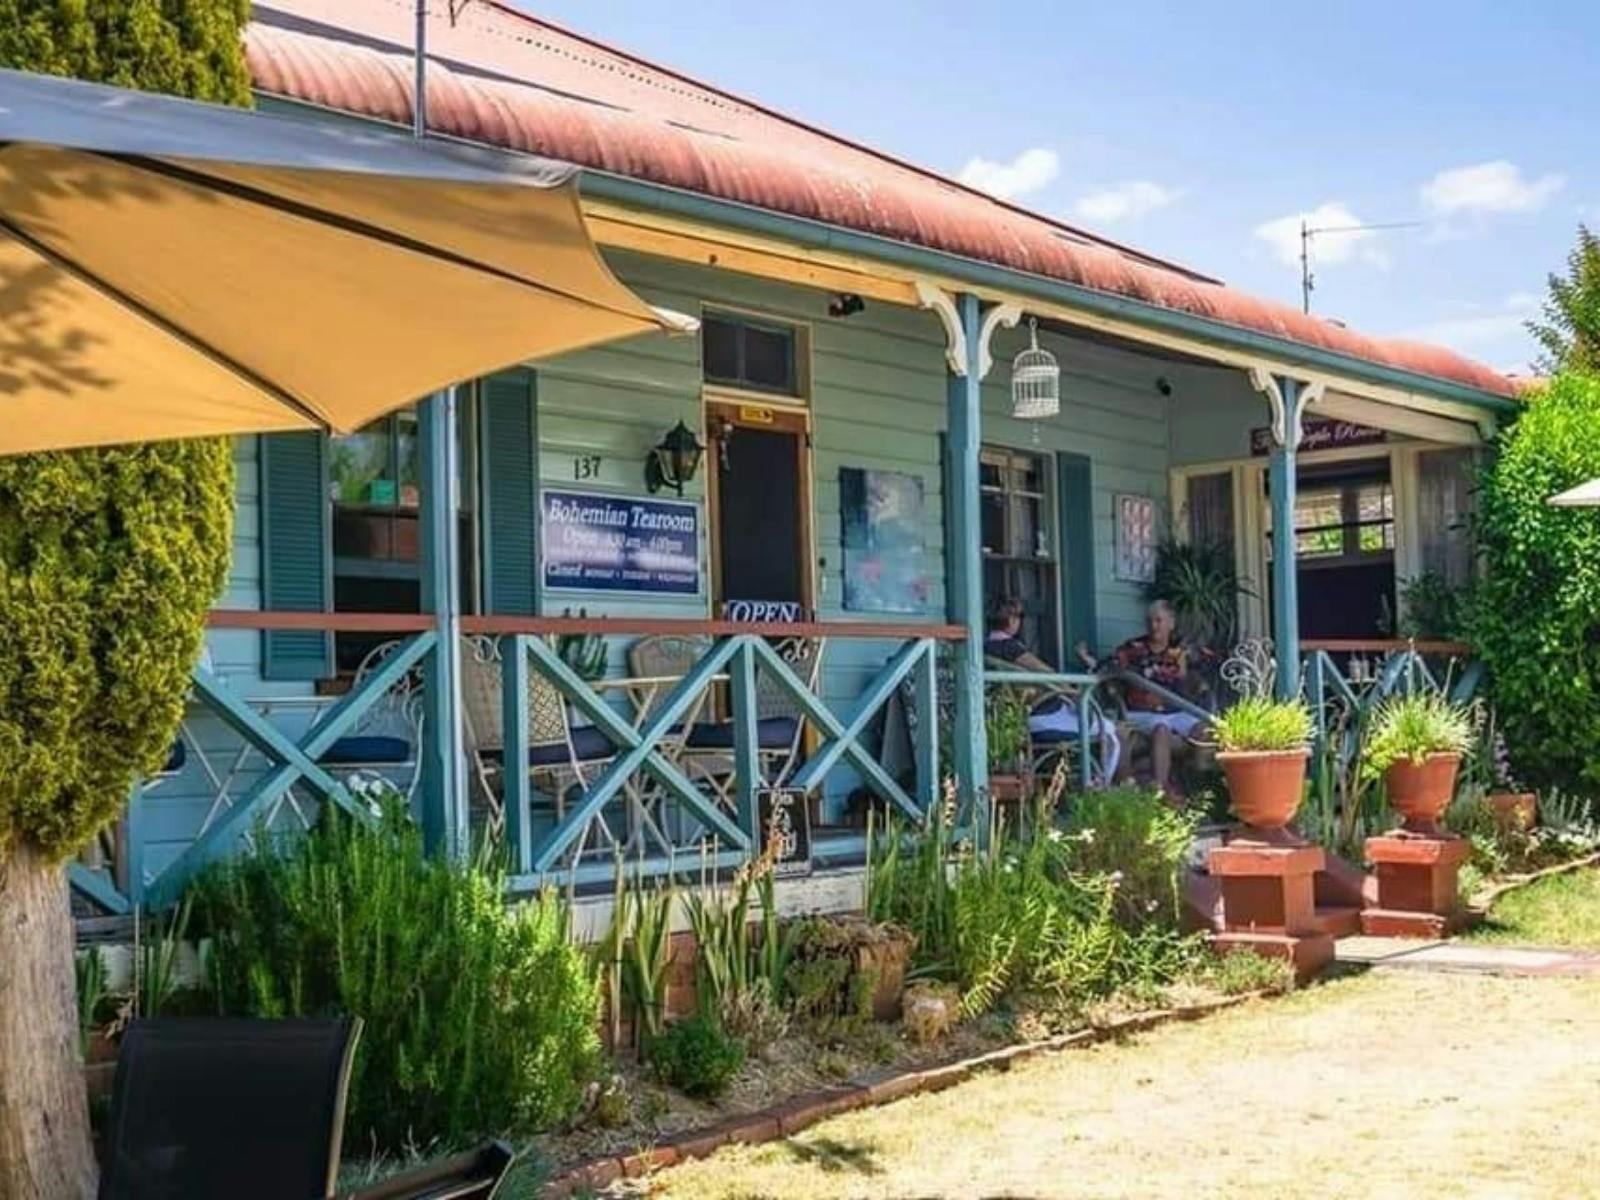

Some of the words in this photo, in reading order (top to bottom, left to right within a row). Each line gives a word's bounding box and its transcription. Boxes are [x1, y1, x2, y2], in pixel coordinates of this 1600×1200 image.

[574, 455, 601, 480] 137
[550, 499, 628, 526] Bohemian
[631, 506, 695, 531] Tearoom
[732, 602, 799, 623] OPEN
